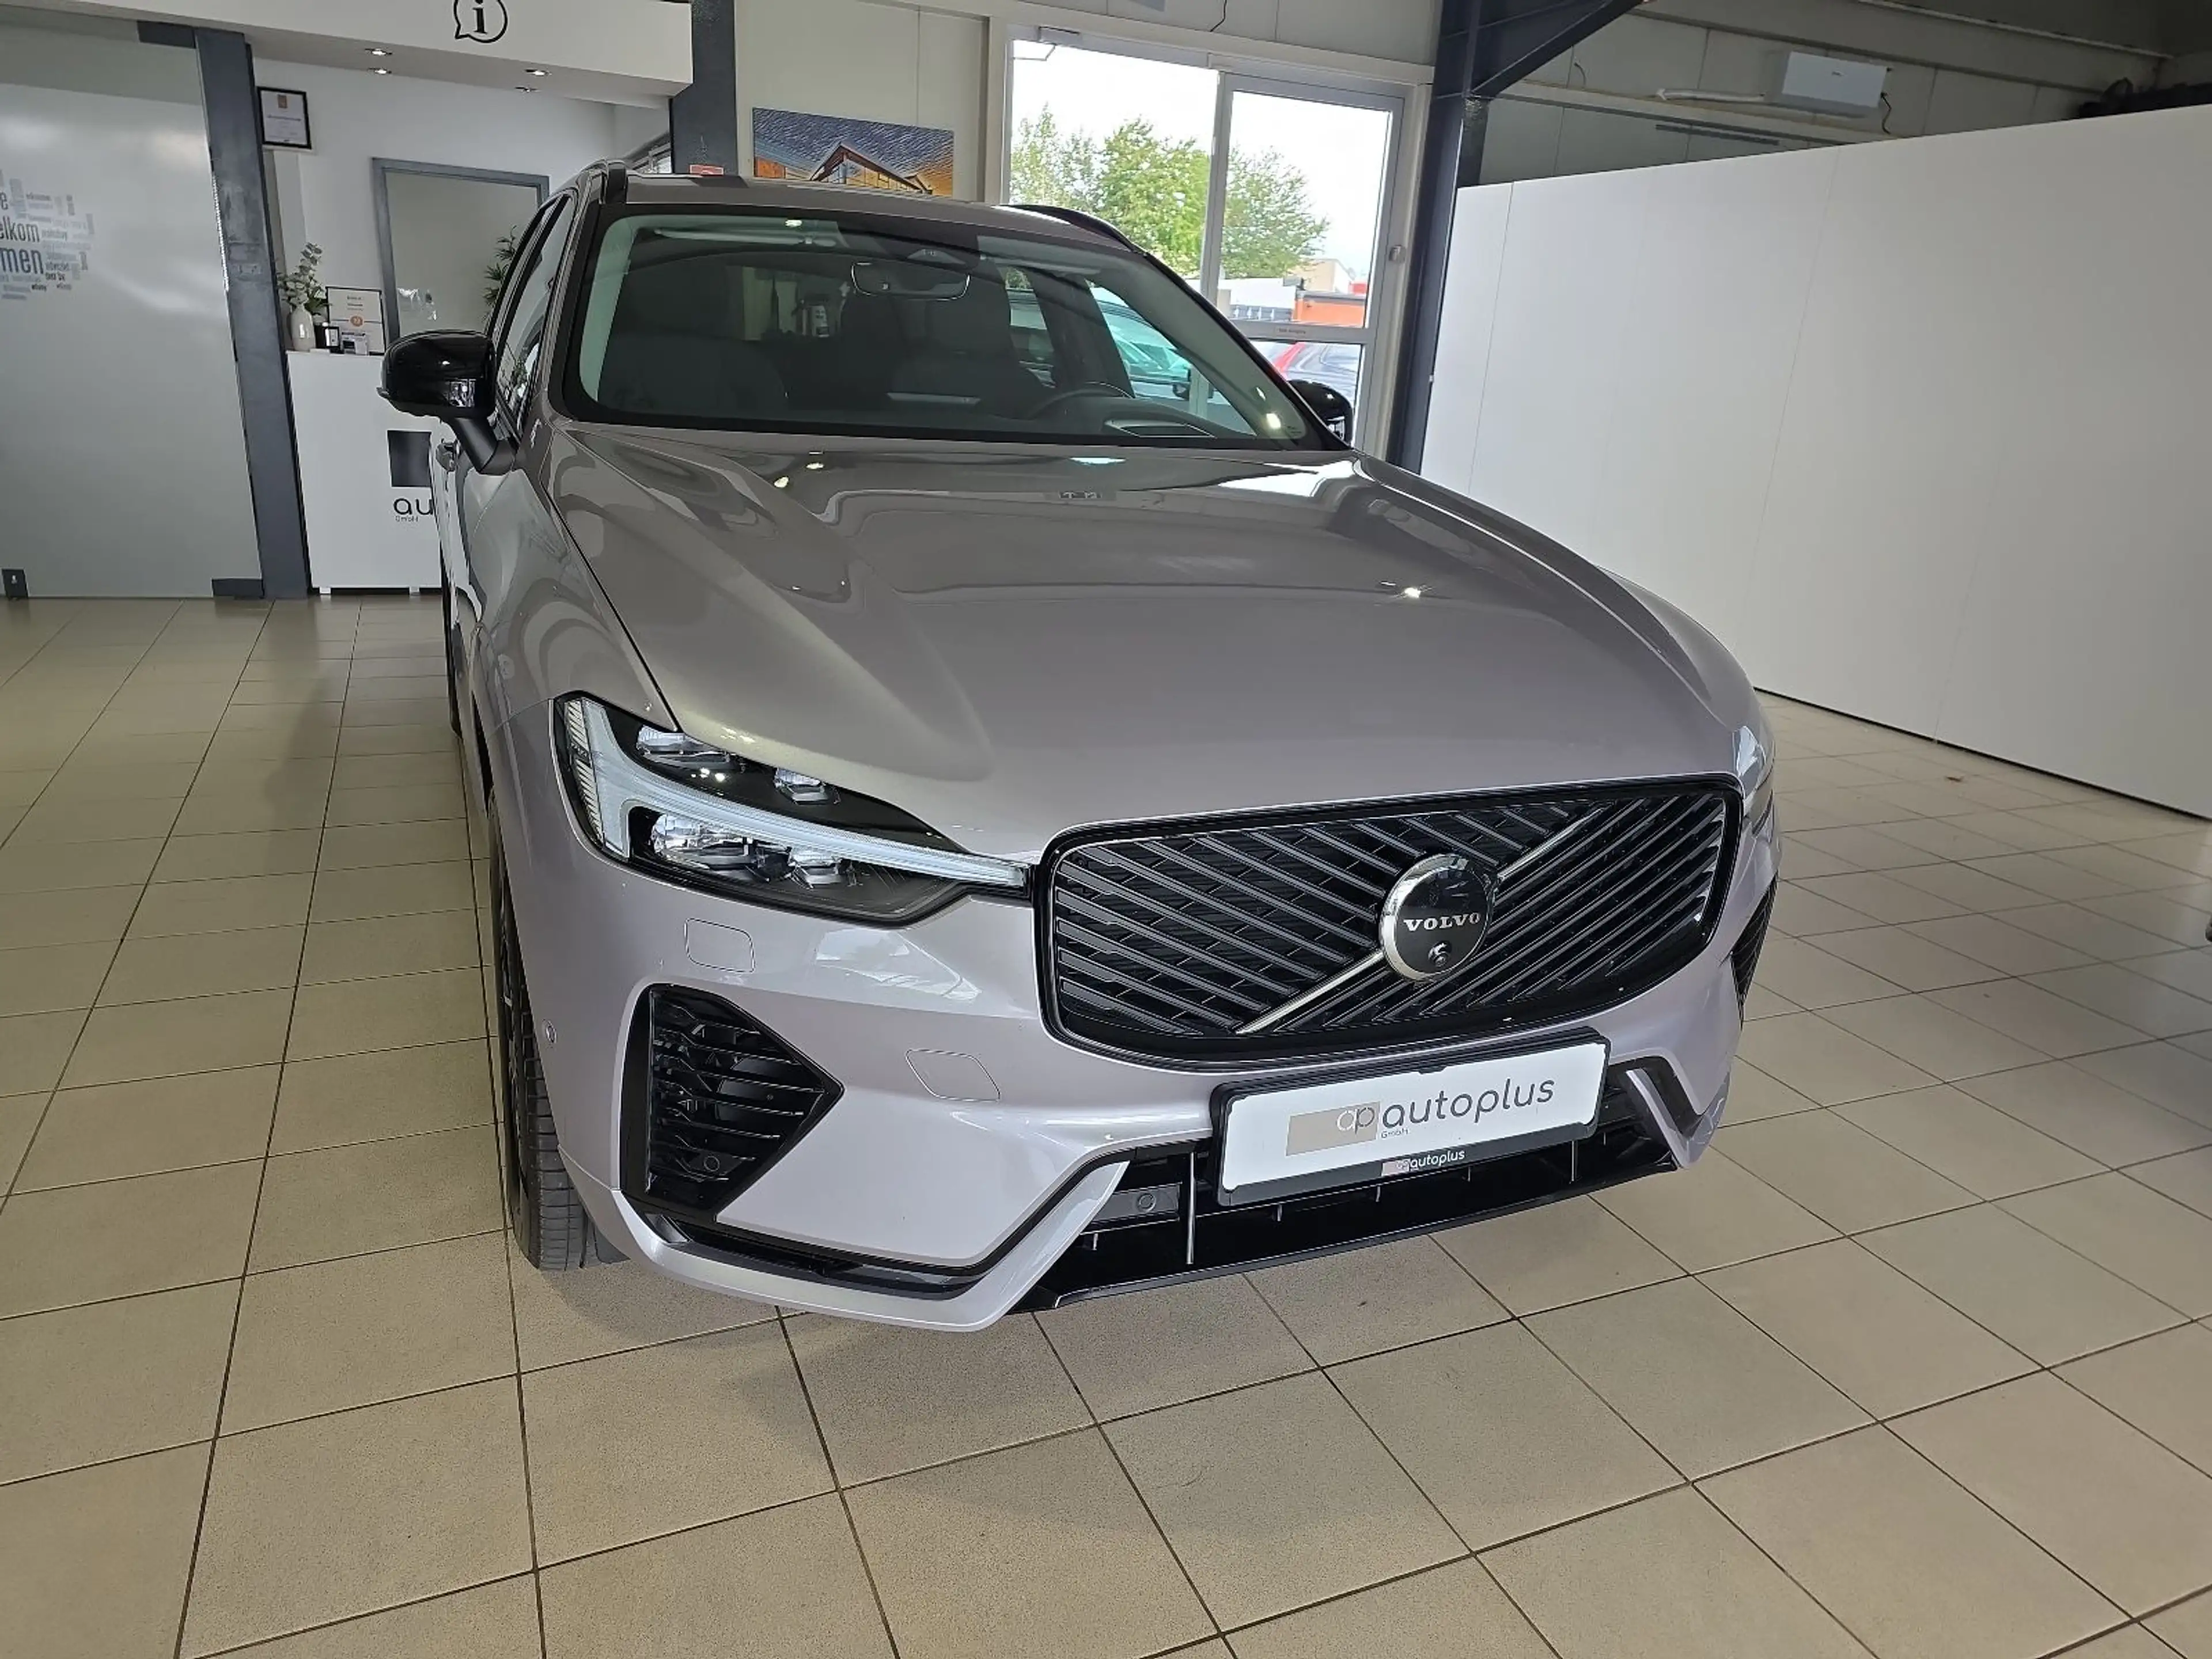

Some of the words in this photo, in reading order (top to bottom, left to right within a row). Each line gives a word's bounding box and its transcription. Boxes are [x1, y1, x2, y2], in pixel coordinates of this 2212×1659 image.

[1403, 912, 1481, 931] VOLVO
[1382, 1078, 1555, 1128] autoplus
[1410, 1150, 1465, 1167] autoplus
